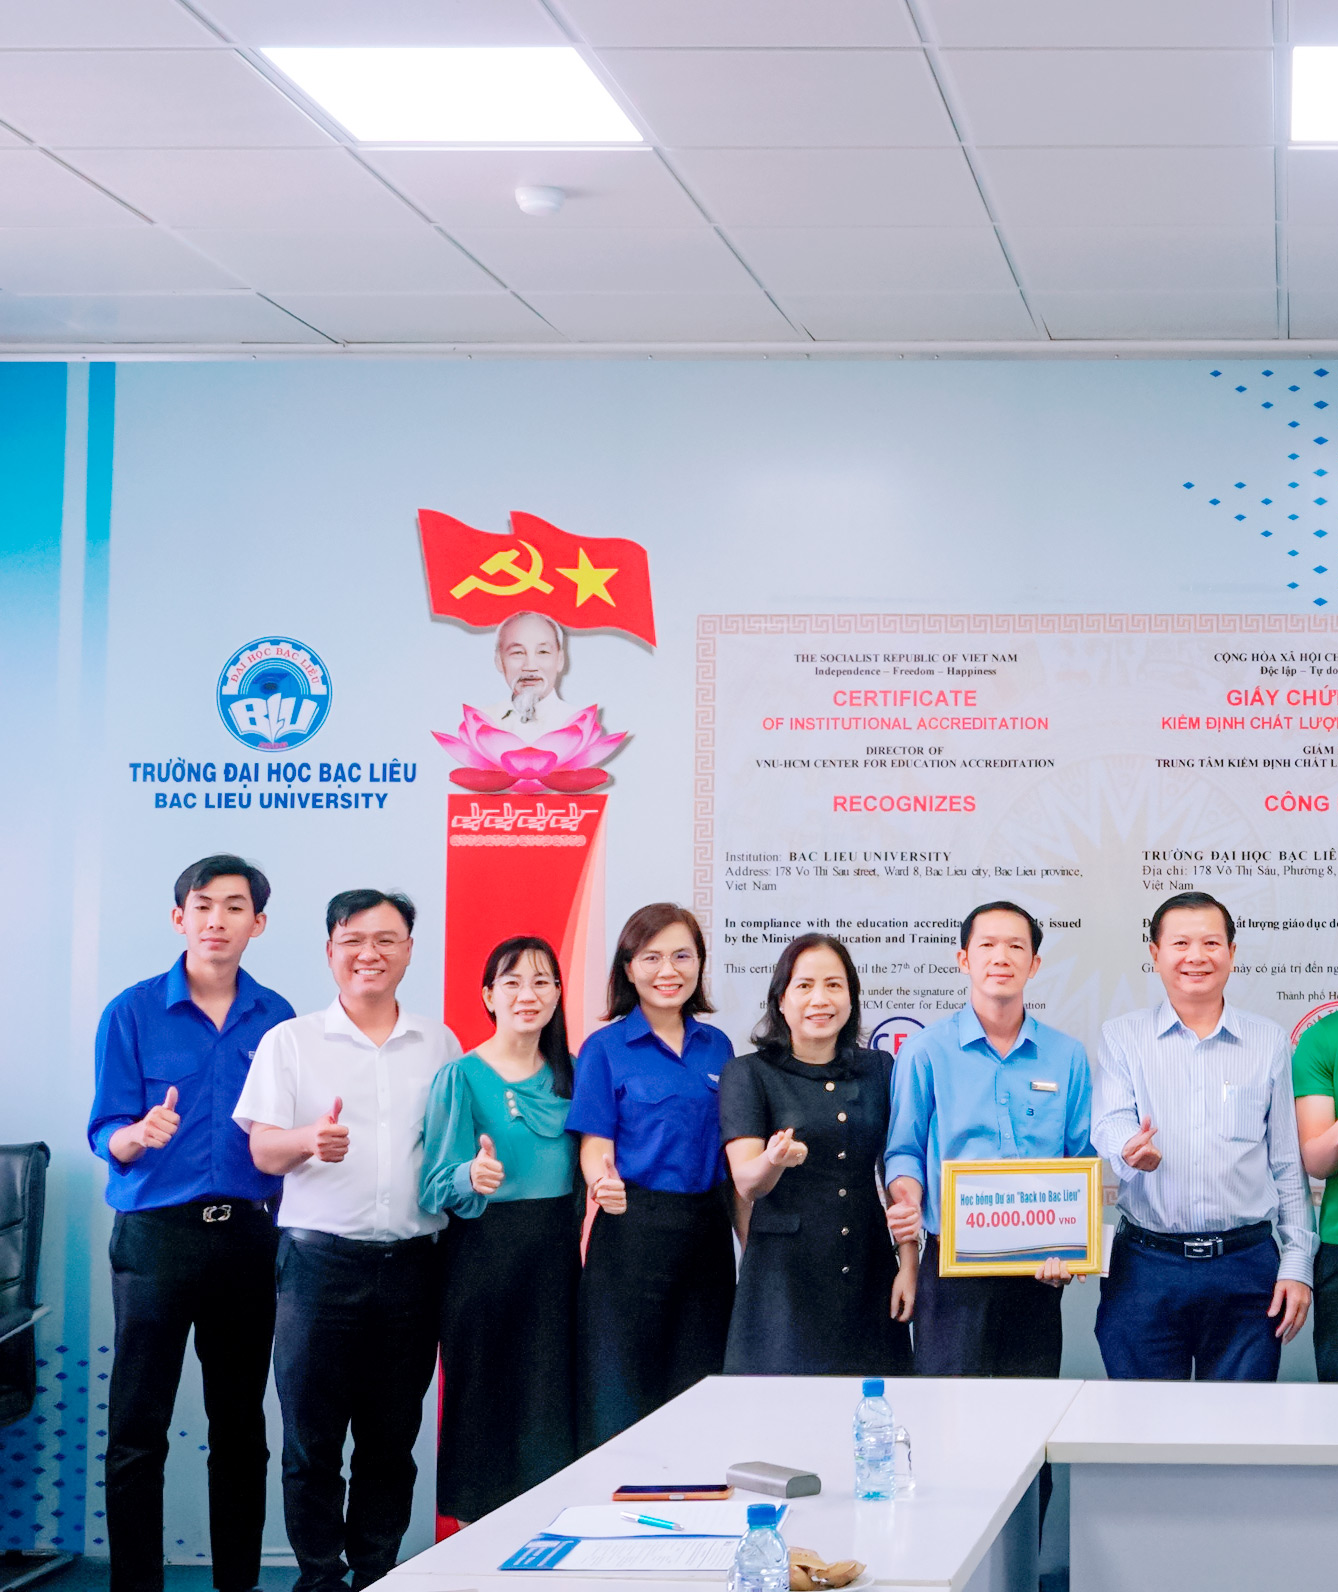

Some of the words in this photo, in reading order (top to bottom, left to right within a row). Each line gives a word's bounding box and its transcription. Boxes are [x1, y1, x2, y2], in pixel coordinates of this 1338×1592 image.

[794, 653, 817, 663] THE
[820, 653, 880, 663] SOCIALIST
[883, 653, 940, 663] REPUBLIC
[943, 653, 959, 663] OF
[962, 653, 989, 663] VIET
[991, 653, 1018, 663] NAM
[1213, 652, 1248, 664] CỘNG
[1251, 650, 1277, 662] HÒA
[1280, 650, 1296, 662] XÃ
[1299, 651, 1321, 664] HỘI
[815, 666, 882, 678] Independence
[893, 666, 935, 678] Freedom
[947, 666, 997, 678] Happiness
[832, 689, 977, 708] CERTIFICATE
[1226, 685, 1280, 707] GIẤY
[762, 717, 785, 731] OF
[789, 716, 913, 731] INSTITUTIONAL
[916, 716, 1049, 731] ACCREDITATION
[1161, 713, 1201, 730] KIỂM
[1205, 716, 1245, 733] ĐỊNH
[1249, 713, 1294, 730] CHẤT
[866, 746, 924, 756] DIRECTOR
[928, 746, 945, 756] OF
[756, 759, 810, 769] VNU-HCM
[814, 759, 859, 769] CENTER
[864, 759, 887, 769] FOR
[891, 759, 957, 769] EDUCATION
[960, 759, 1055, 769] ACCREDITATION
[1156, 758, 1195, 768] TRUNG
[128, 756, 217, 783] TRƯỜNG
[223, 762, 260, 789] ĐẠI
[267, 761, 312, 789] HỌC
[318, 762, 362, 789] BẠC
[369, 757, 417, 783] LIÊU
[154, 792, 197, 810] BAC
[204, 792, 252, 810] LIEU
[259, 792, 389, 810] UNIVERSITY
[833, 795, 977, 813] RECOGNIZES
[1264, 790, 1330, 813] CÔNG
[725, 851, 782, 862] Institution:
[789, 851, 818, 862] BAC
[825, 851, 858, 862] LIEU
[864, 851, 952, 862] UNIVERSITY
[1142, 849, 1204, 861] TRƯỜNG
[1211, 850, 1236, 862] ĐẠI
[1241, 850, 1272, 863] HỌC
[1279, 850, 1308, 863] BẠC
[725, 865, 772, 877] Address:
[775, 866, 792, 877] 178
[795, 865, 810, 876] Vo
[812, 865, 828, 877] Thi
[832, 865, 850, 877] Sau
[853, 867, 880, 877] street,
[884, 865, 909, 877] Ward
[912, 865, 922, 877] 8,
[925, 866, 944, 877] Bac
[946, 865, 967, 877] Lieu
[971, 867, 991, 879] city,
[994, 866, 1013, 877] Bac
[1016, 866, 1037, 877] Lieu
[1040, 868, 1083, 879] province,
[1193, 865, 1212, 876] 178
[725, 880, 747, 891] Viet
[752, 880, 777, 891] Nam
[1142, 879, 1164, 892] Việt
[1169, 880, 1194, 891] Nam
[725, 917, 736, 928] In
[740, 918, 802, 931] compliance
[806, 918, 830, 928] with
[835, 918, 853, 928] the
[856, 917, 909, 928] education
[913, 918, 961, 929] accredita
[1049, 917, 1082, 929] issued
[724, 933, 738, 946] by
[741, 933, 759, 944] the
[761, 933, 796, 944] Minist
[885, 933, 905, 944] and
[911, 933, 957, 946] Training
[723, 963, 746, 974] This
[871, 963, 888, 974] the
[913, 963, 926, 974] of
[867, 986, 894, 996] under
[896, 986, 911, 996] the
[913, 986, 955, 998] signature
[957, 986, 969, 996] of
[885, 1000, 915, 1010] Center
[919, 999, 932, 1010] for
[1039, 1191, 1047, 1202] to
[966, 1209, 1056, 1228] 40.000.000
[1058, 1217, 1077, 1226] VND
